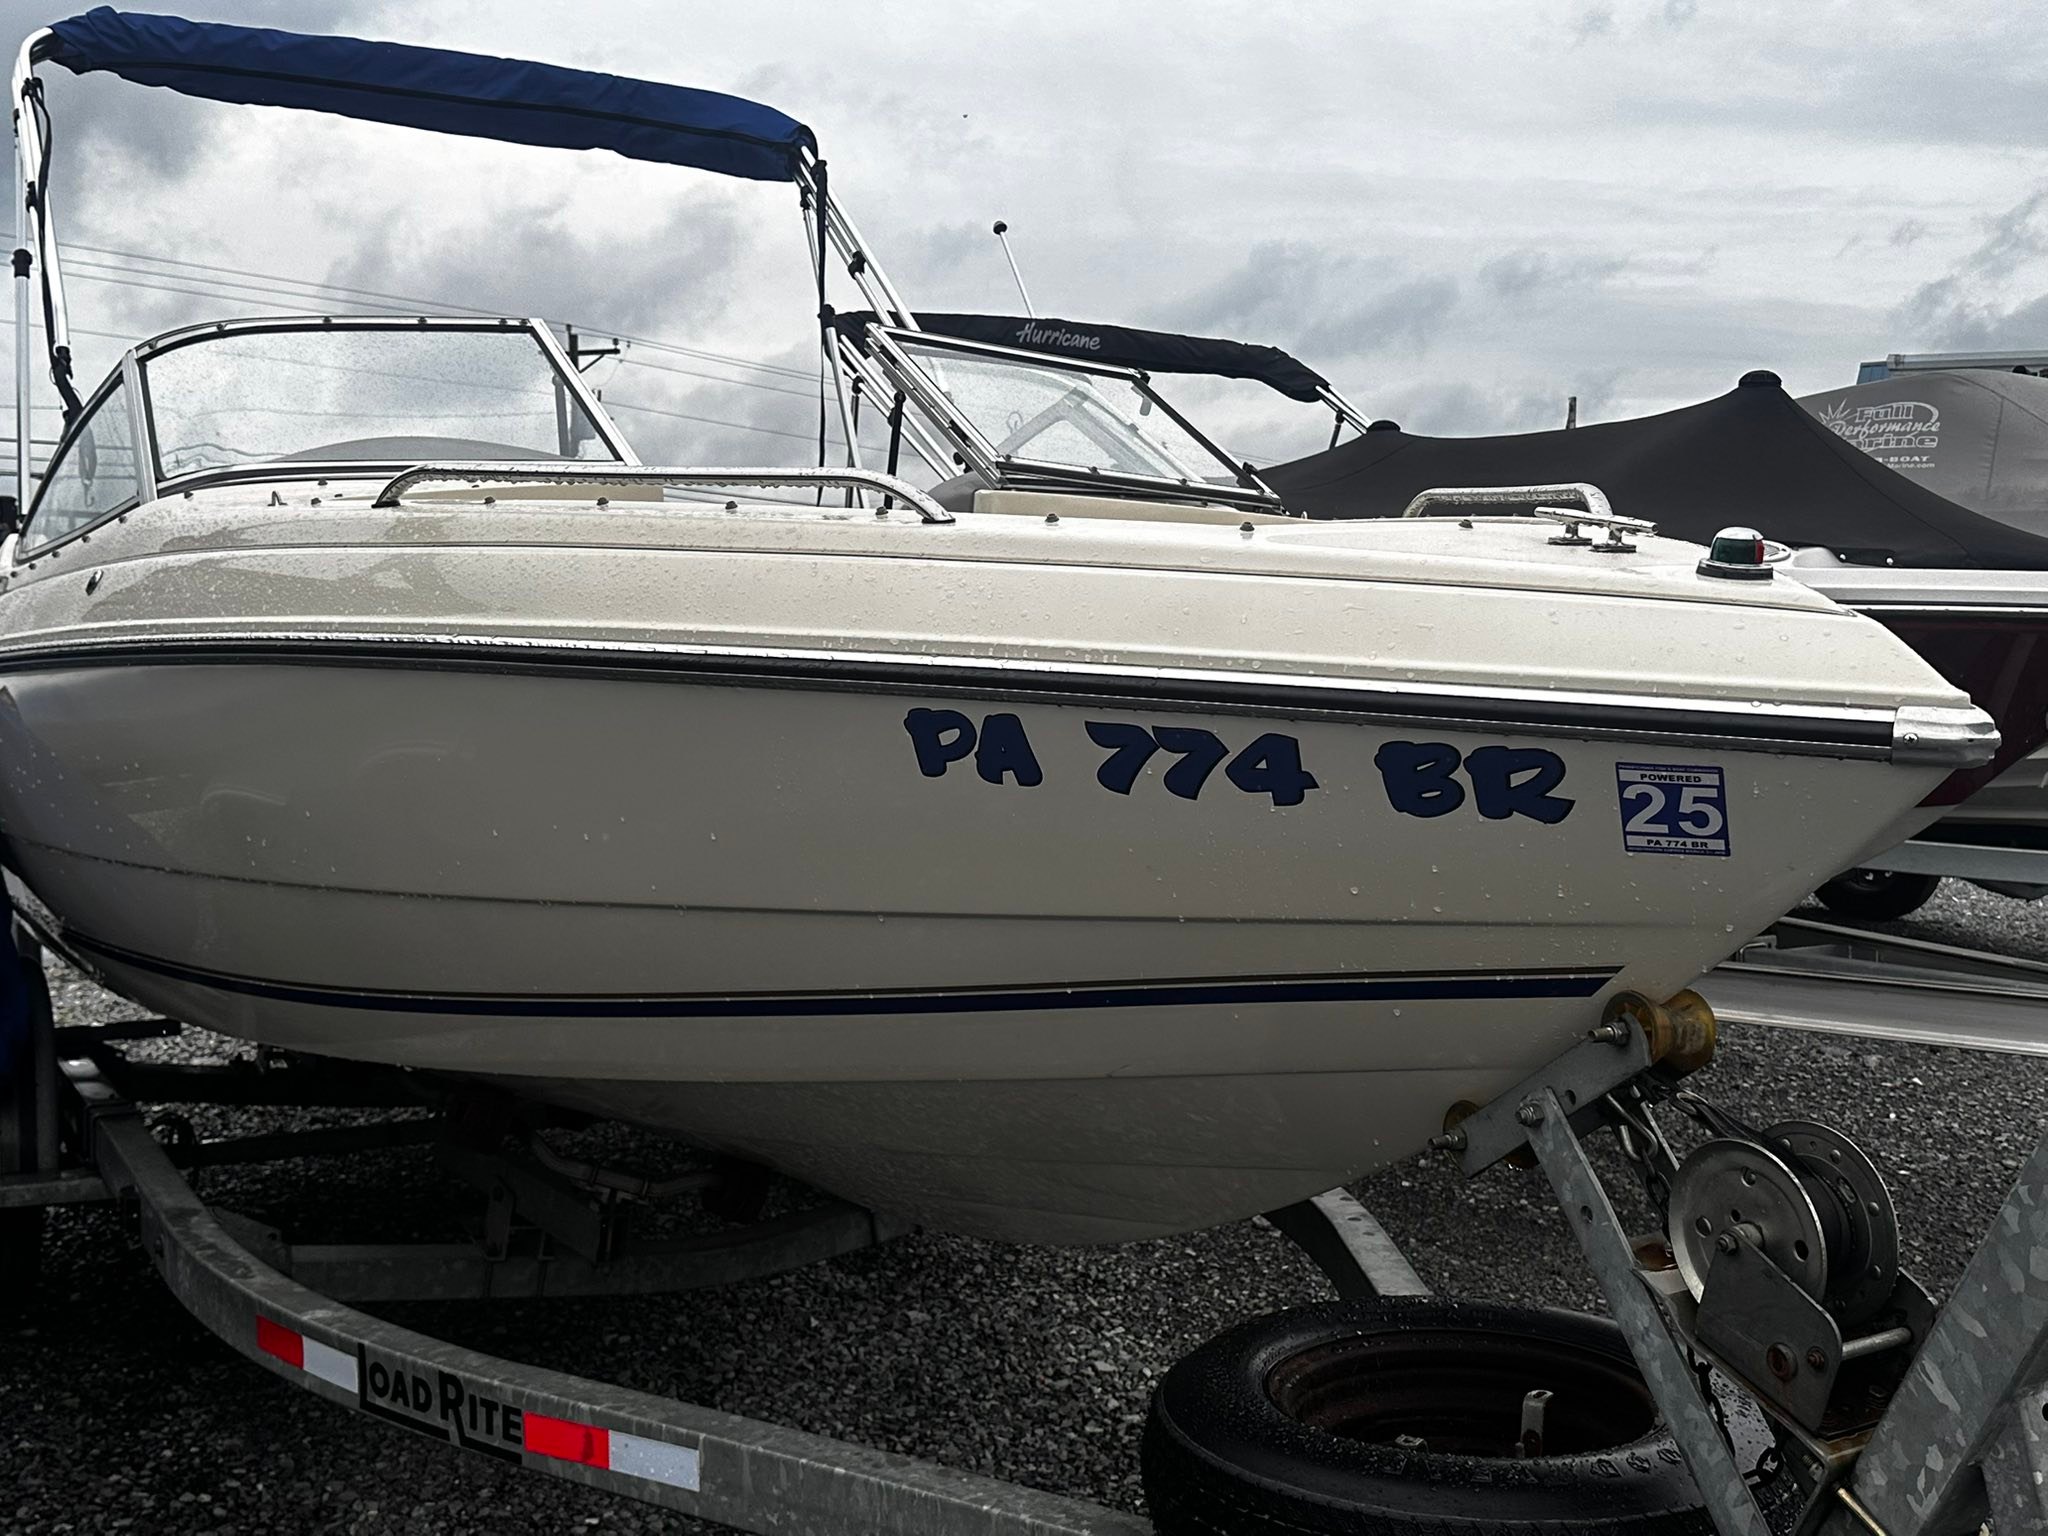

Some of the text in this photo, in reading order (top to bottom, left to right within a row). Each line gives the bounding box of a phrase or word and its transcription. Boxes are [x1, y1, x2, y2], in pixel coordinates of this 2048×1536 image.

[1016, 321, 1101, 350] Hurricane
[1855, 403, 1915, 423] Full
[1829, 419, 1941, 440] Performance
[1846, 433, 1938, 450] arine
[904, 707, 1577, 825] PA 774 BR
[1640, 773, 1702, 783] POWERED
[1622, 783, 1723, 837] 25
[1646, 838, 1709, 849] PA 774 BR
